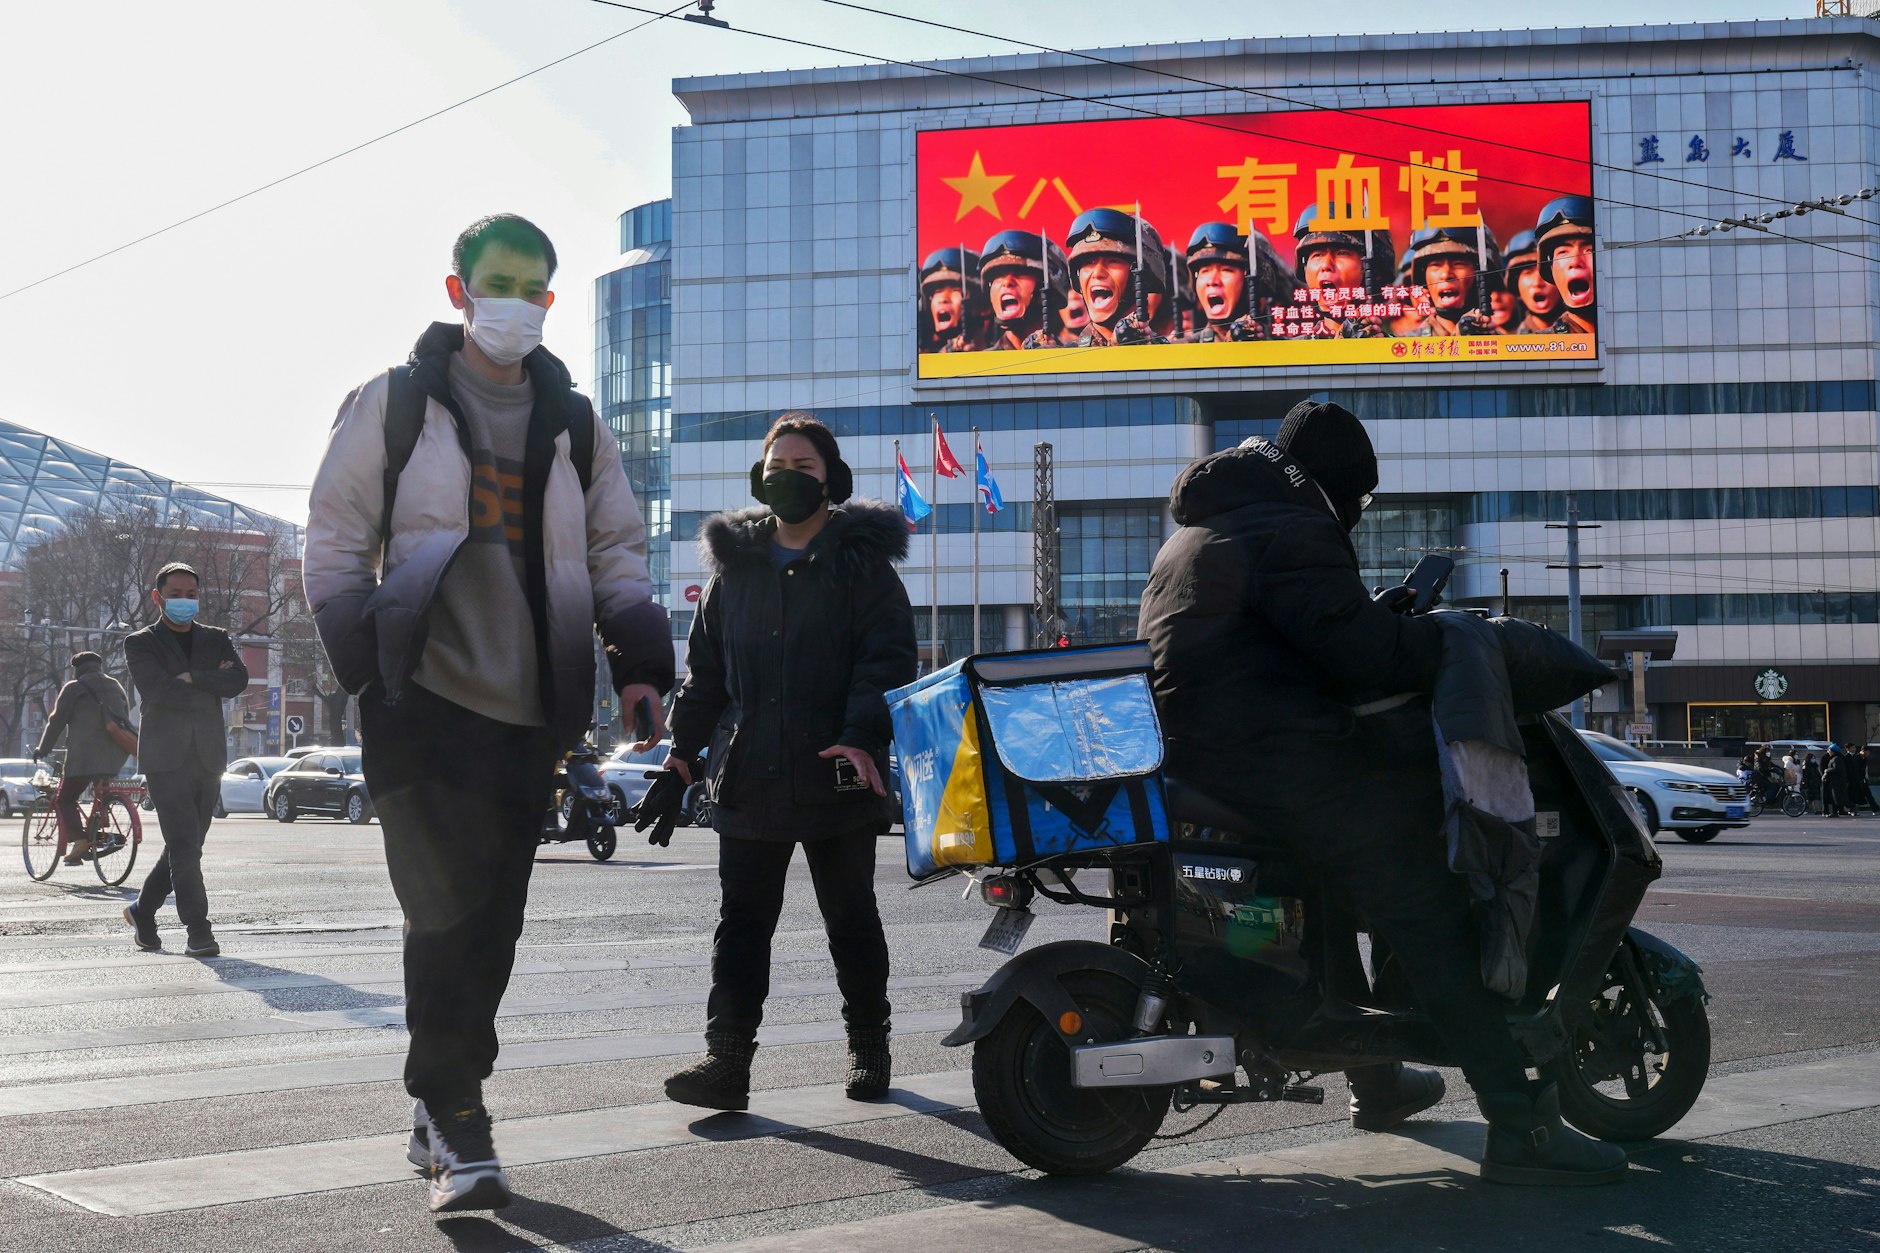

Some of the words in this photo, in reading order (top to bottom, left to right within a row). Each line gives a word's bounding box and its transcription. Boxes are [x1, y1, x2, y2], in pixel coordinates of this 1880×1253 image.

[1216, 149, 1483, 237] 有血性
[1506, 341, 1588, 353] www.81.cn
[1284, 464, 1306, 488] the
[1181, 865, 1228, 881] 五星钻豹
